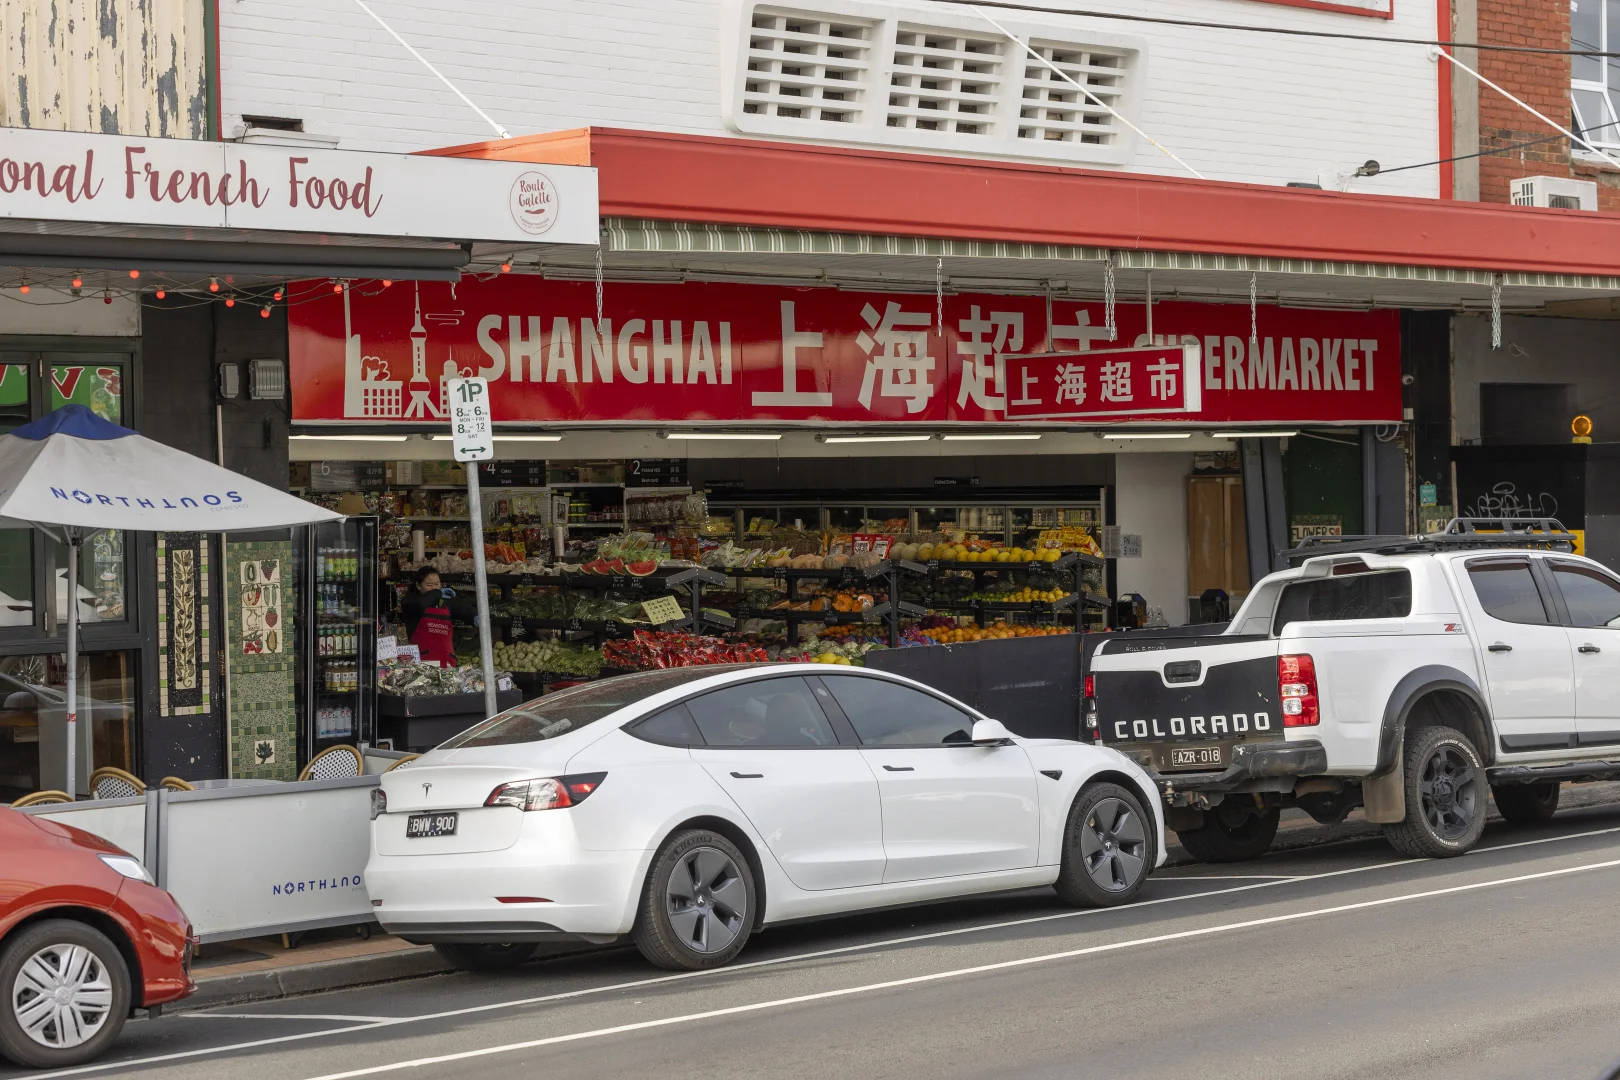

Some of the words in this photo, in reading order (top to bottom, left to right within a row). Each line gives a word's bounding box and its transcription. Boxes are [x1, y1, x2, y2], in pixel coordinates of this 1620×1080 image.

[0, 149, 104, 203] onal
[125, 146, 270, 208] French
[289, 157, 383, 218] Food
[518, 191, 551, 207] Galette
[476, 314, 732, 385] SHANGHAI
[1134, 333, 1378, 391] ERMARKET
[1011, 357, 1180, 406] 上海超市
[457, 382, 483, 403] 1P
[476, 422, 485, 430] 12
[321, 460, 331, 476] 6
[486, 463, 496, 475] 4
[633, 460, 641, 475] 2
[1115, 712, 1271, 739] COLORADO
